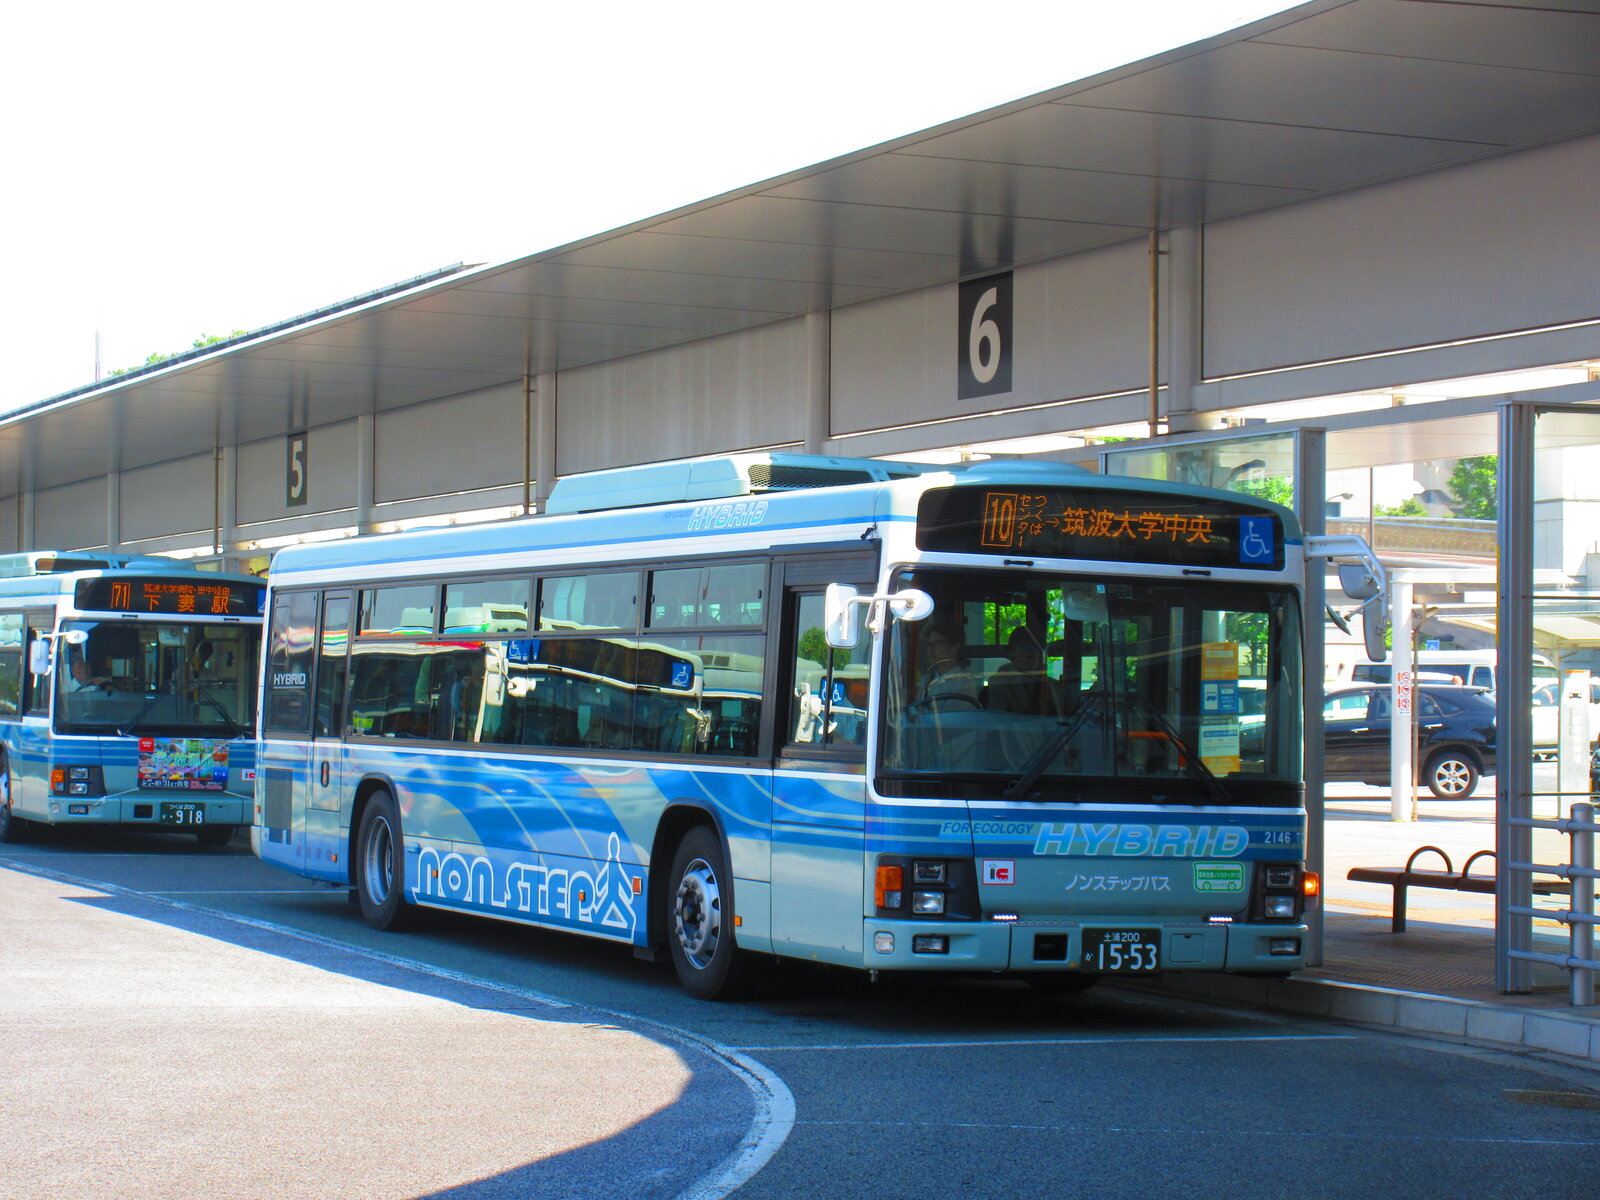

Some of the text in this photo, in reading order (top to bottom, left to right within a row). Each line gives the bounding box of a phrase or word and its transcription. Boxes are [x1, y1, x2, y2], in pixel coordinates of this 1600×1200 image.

[969, 286, 1001, 383] 6
[291, 440, 303, 498] 5
[687, 501, 769, 530] HYBRID
[990, 498, 1013, 541] 10
[1061, 506, 1212, 544] 筑波大学中央
[113, 584, 129, 609] 71
[273, 673, 306, 686] HYBRID
[943, 822, 1034, 834] FOR ECOLOGY
[1033, 822, 1250, 858] HYBRID
[1264, 831, 1291, 844] 2146
[1065, 875, 1171, 891] ノンステップバス
[1098, 943, 1157, 970] 15-53
